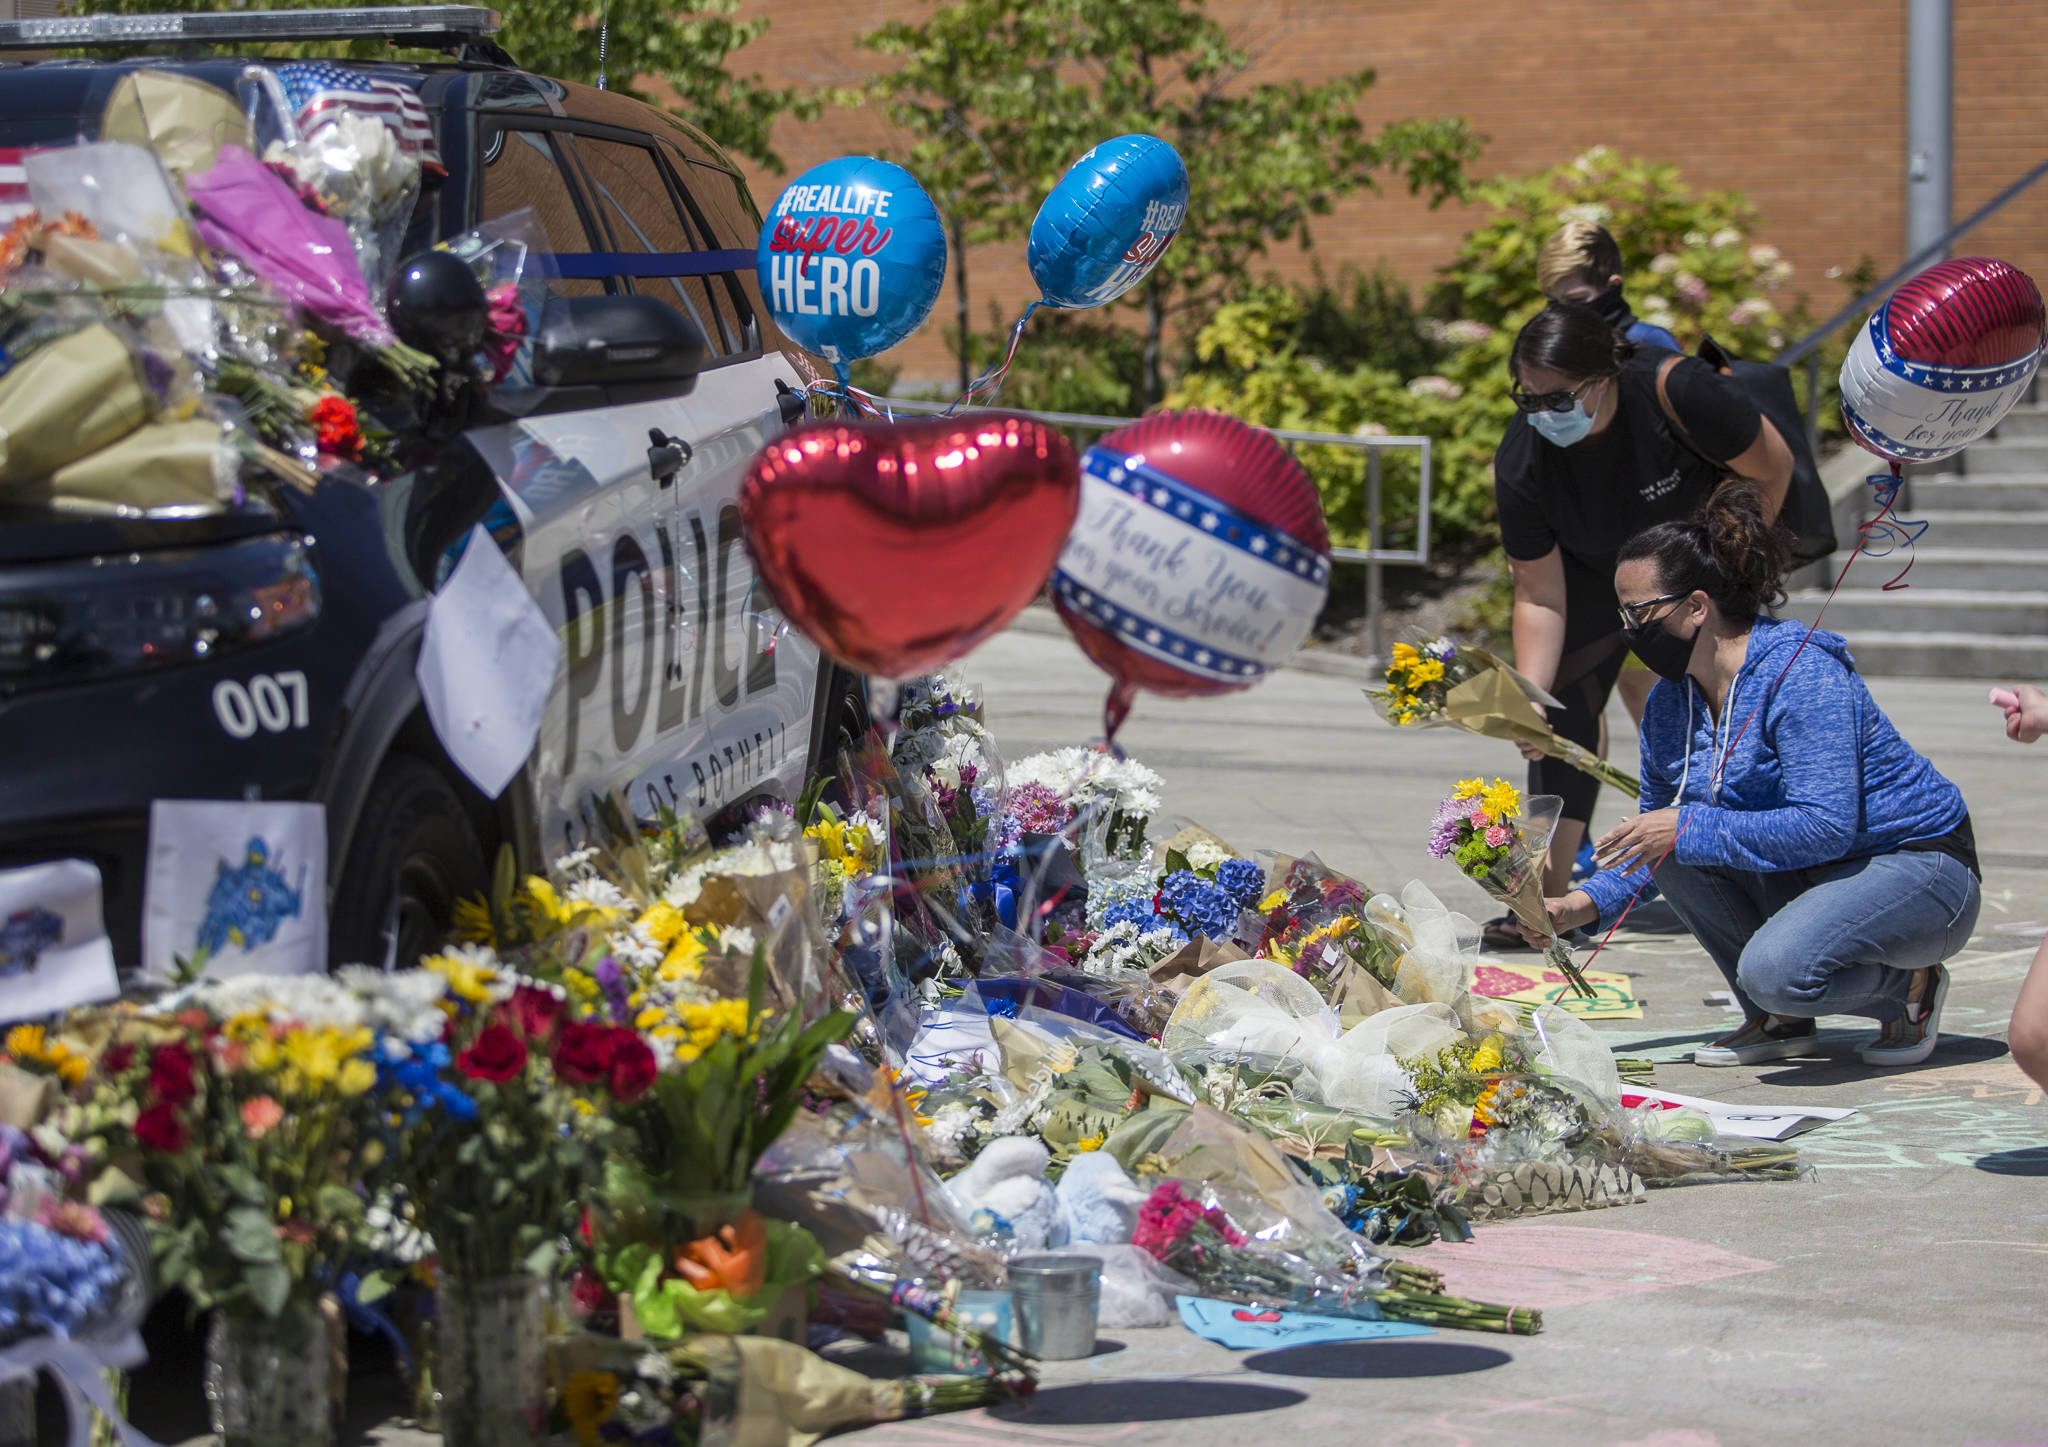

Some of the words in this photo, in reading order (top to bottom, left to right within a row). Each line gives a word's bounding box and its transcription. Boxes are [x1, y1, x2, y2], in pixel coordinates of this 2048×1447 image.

[776, 184, 893, 218] #REALLIFE
[768, 213, 893, 277] super
[771, 255, 880, 317] HERO
[1904, 424, 1936, 444] for
[1924, 392, 2004, 427] Thank
[1087, 500, 1193, 578] Thank
[1204, 552, 1268, 612] You
[559, 503, 777, 778] POLICE
[211, 670, 310, 740] 007
[692, 721, 787, 808] BOTHELL
